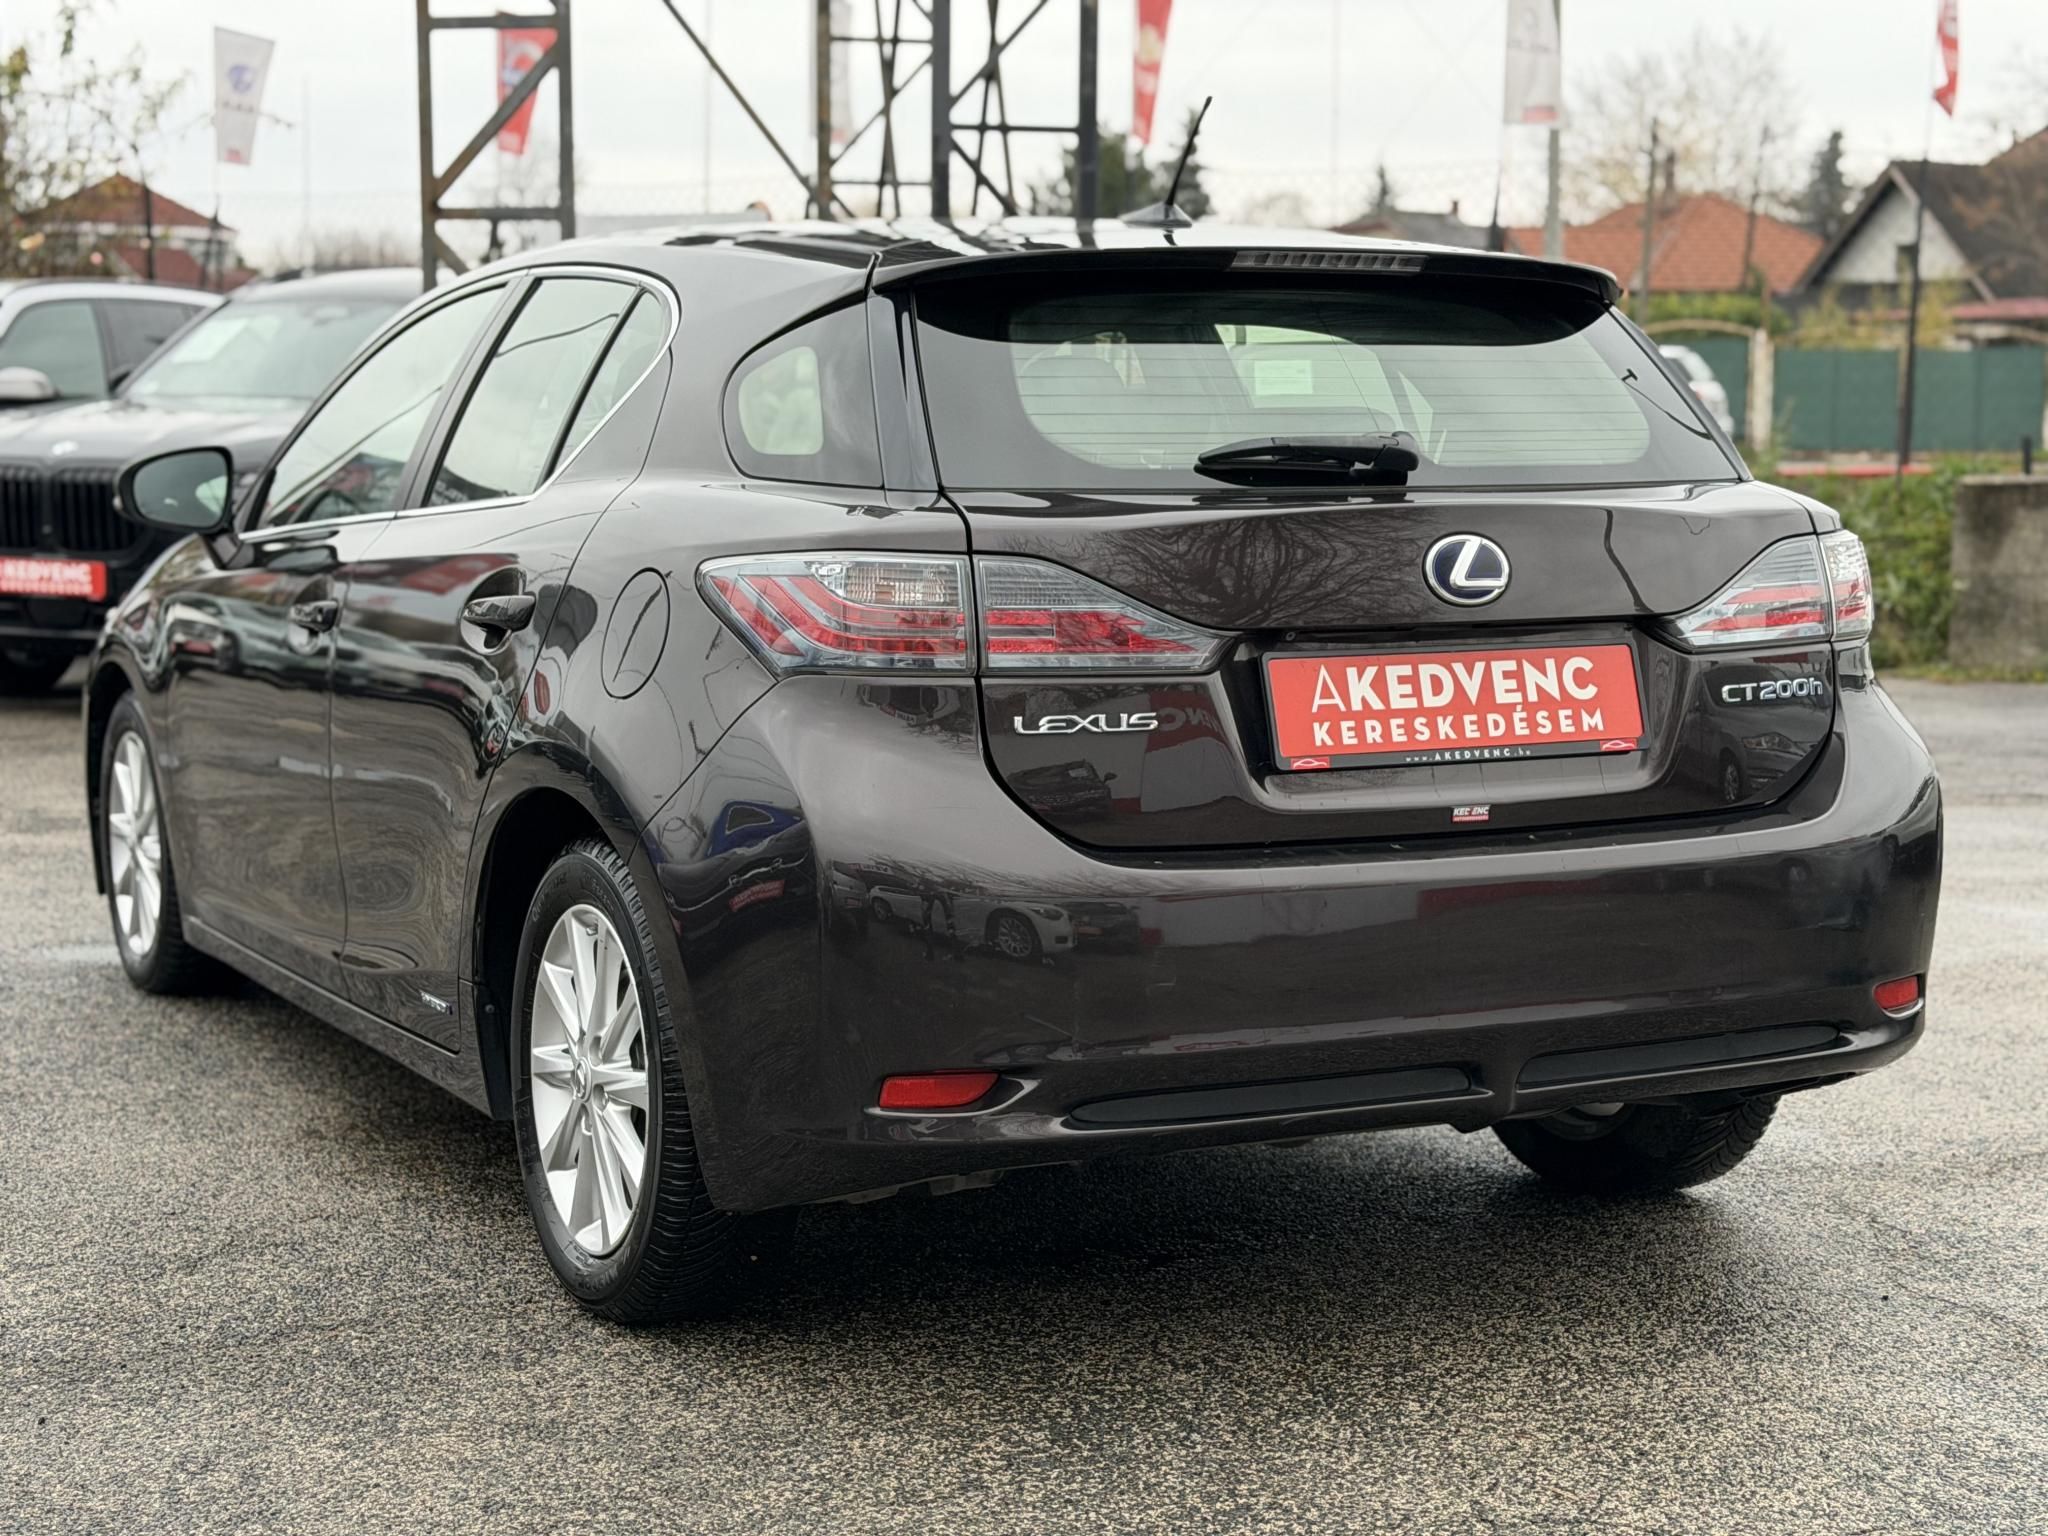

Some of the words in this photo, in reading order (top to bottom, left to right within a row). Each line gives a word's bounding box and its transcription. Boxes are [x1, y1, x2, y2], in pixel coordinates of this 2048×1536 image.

[1311, 656, 1599, 713] AKEDVENC
[1721, 677, 1823, 702] CT200h
[1013, 712, 1159, 735] LEXUS
[1313, 704, 1604, 747] KERESKEDÉSEM
